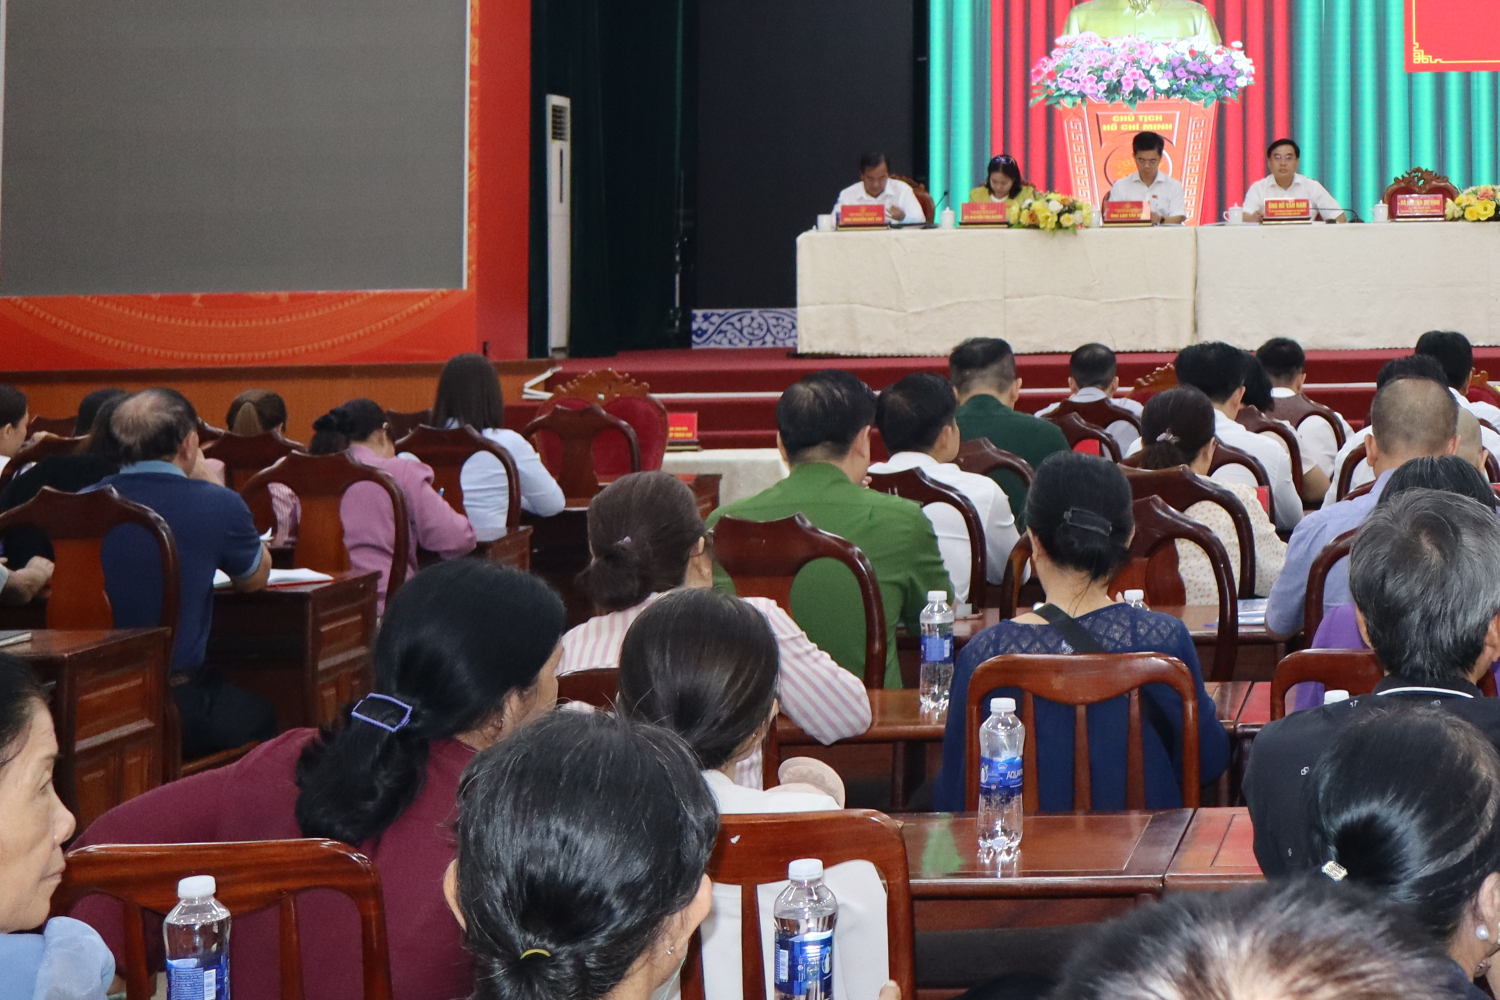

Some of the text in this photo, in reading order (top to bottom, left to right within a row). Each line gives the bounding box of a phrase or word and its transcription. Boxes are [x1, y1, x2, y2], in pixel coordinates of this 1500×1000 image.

[1112, 113, 1163, 123] CHỦ TỊCH
[1121, 123, 1140, 131] CHÍ
